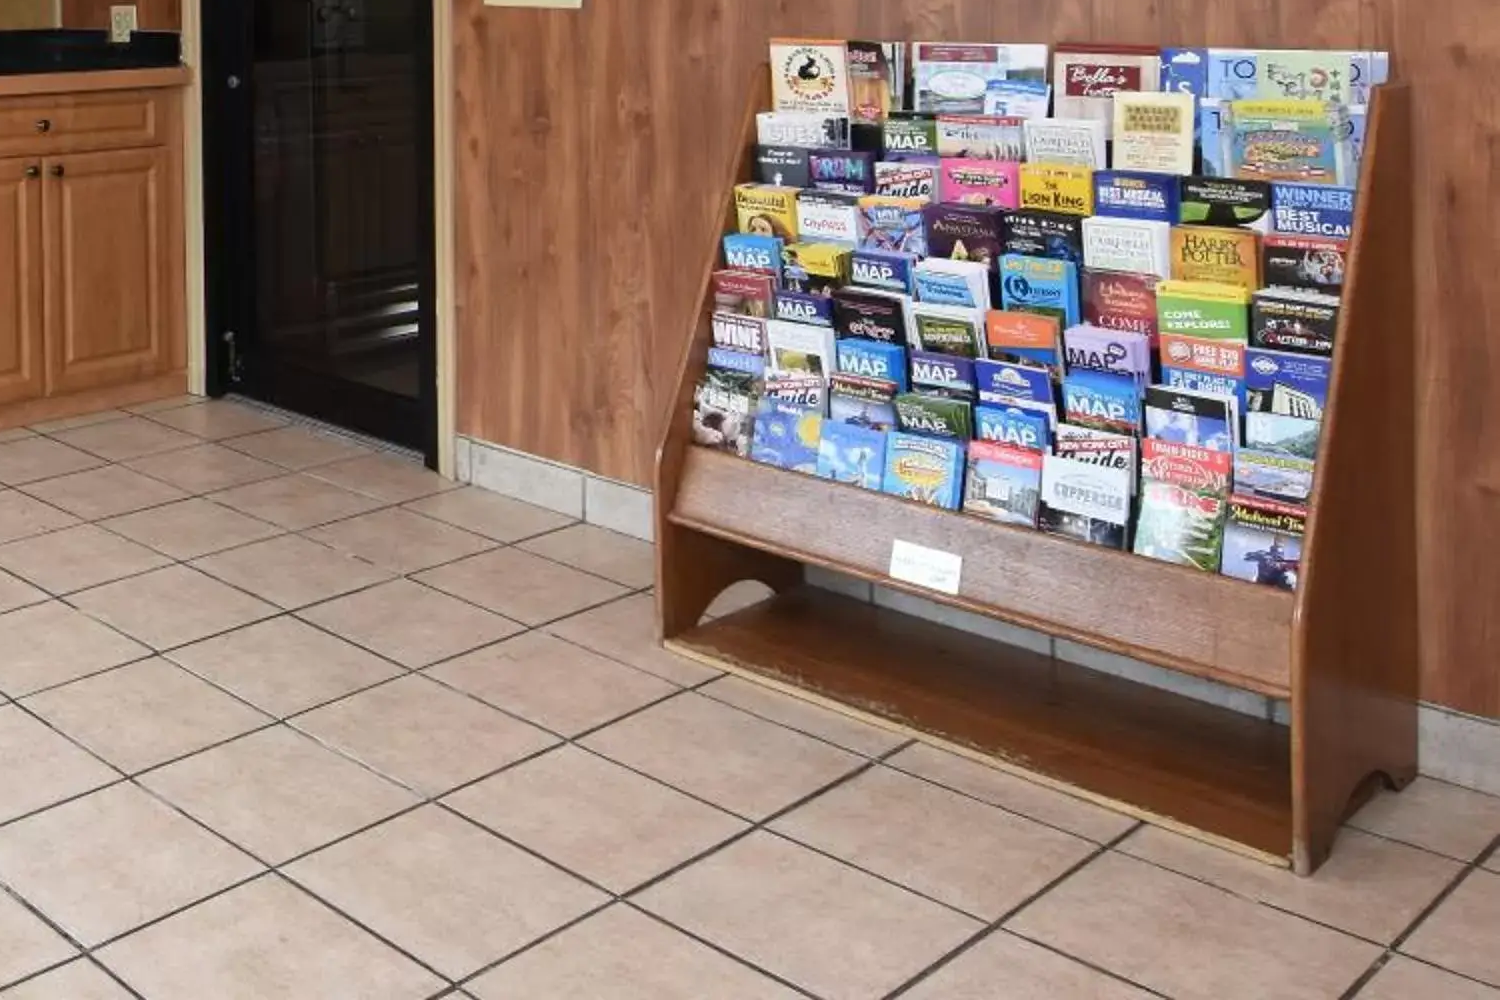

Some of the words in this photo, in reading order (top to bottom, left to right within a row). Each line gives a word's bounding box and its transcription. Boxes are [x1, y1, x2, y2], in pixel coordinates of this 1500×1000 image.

[885, 134, 927, 150] MAP
[1022, 188, 1052, 206] LION
[1053, 190, 1086, 207] KING
[1275, 186, 1352, 205] WINNER
[1276, 206, 1320, 222] BEST
[1184, 233, 1238, 252] HARRY
[726, 249, 771, 268] MAP
[1182, 247, 1245, 267] POTTER
[852, 262, 894, 279] MAP
[777, 300, 817, 316] MAP
[713, 321, 762, 352] WINE
[839, 354, 888, 377] MAP
[1067, 347, 1120, 369] MAP
[912, 362, 958, 382] MAP
[1067, 395, 1125, 419] MAP
[900, 416, 948, 431] MAP
[981, 421, 1038, 448] MAP
